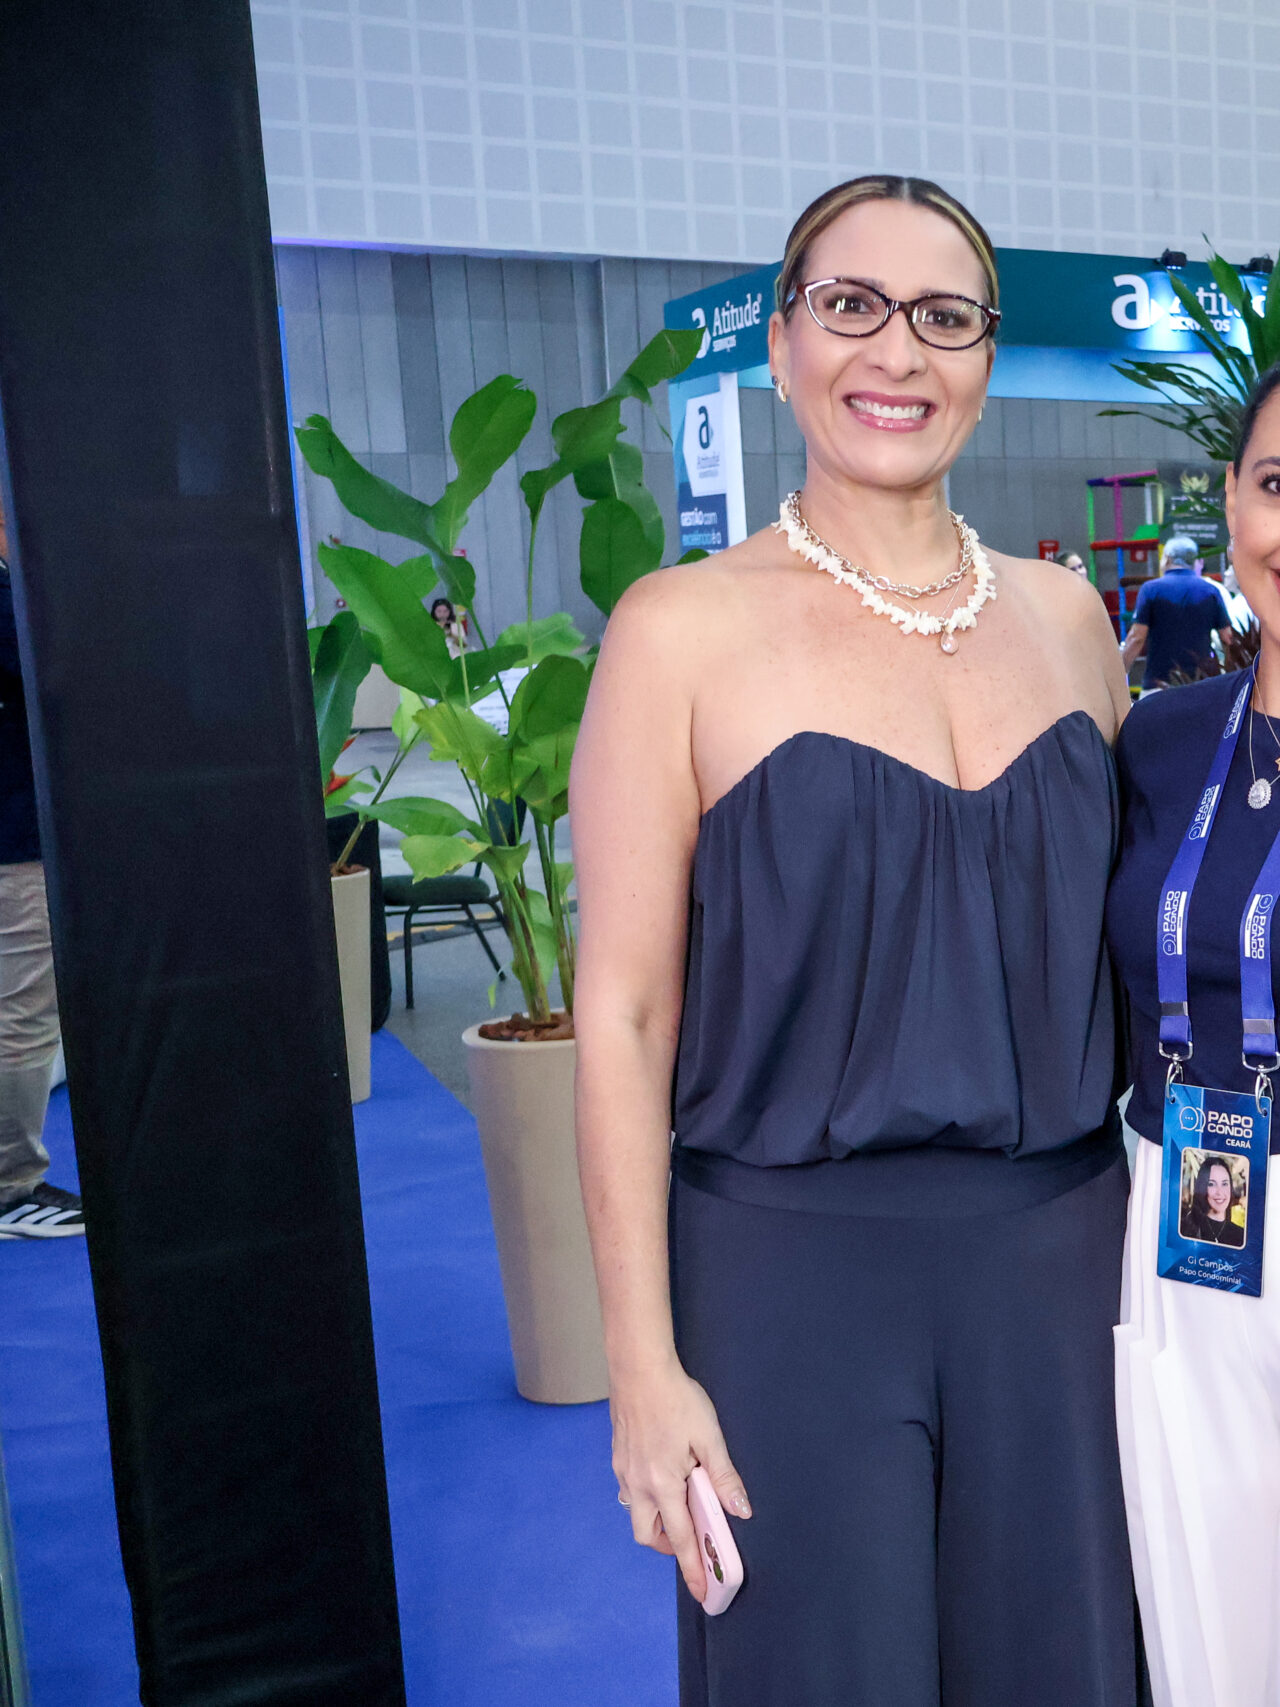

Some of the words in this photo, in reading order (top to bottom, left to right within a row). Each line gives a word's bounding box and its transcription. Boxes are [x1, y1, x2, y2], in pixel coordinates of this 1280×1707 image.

[713, 293, 760, 336] Atitude
[1163, 891, 1174, 932] PAPO
[1170, 891, 1180, 932] CONDO
[1251, 915, 1259, 959] CONDO
[1257, 915, 1267, 960] PAPO
[1207, 1111, 1253, 1128] PAPO
[1207, 1123, 1253, 1138] CONDO
[1226, 1138, 1251, 1149] CEARÁ
[1179, 1266, 1197, 1276] Papo
[1198, 1270, 1242, 1285] Condominial
[1199, 1258, 1234, 1272] Campos
